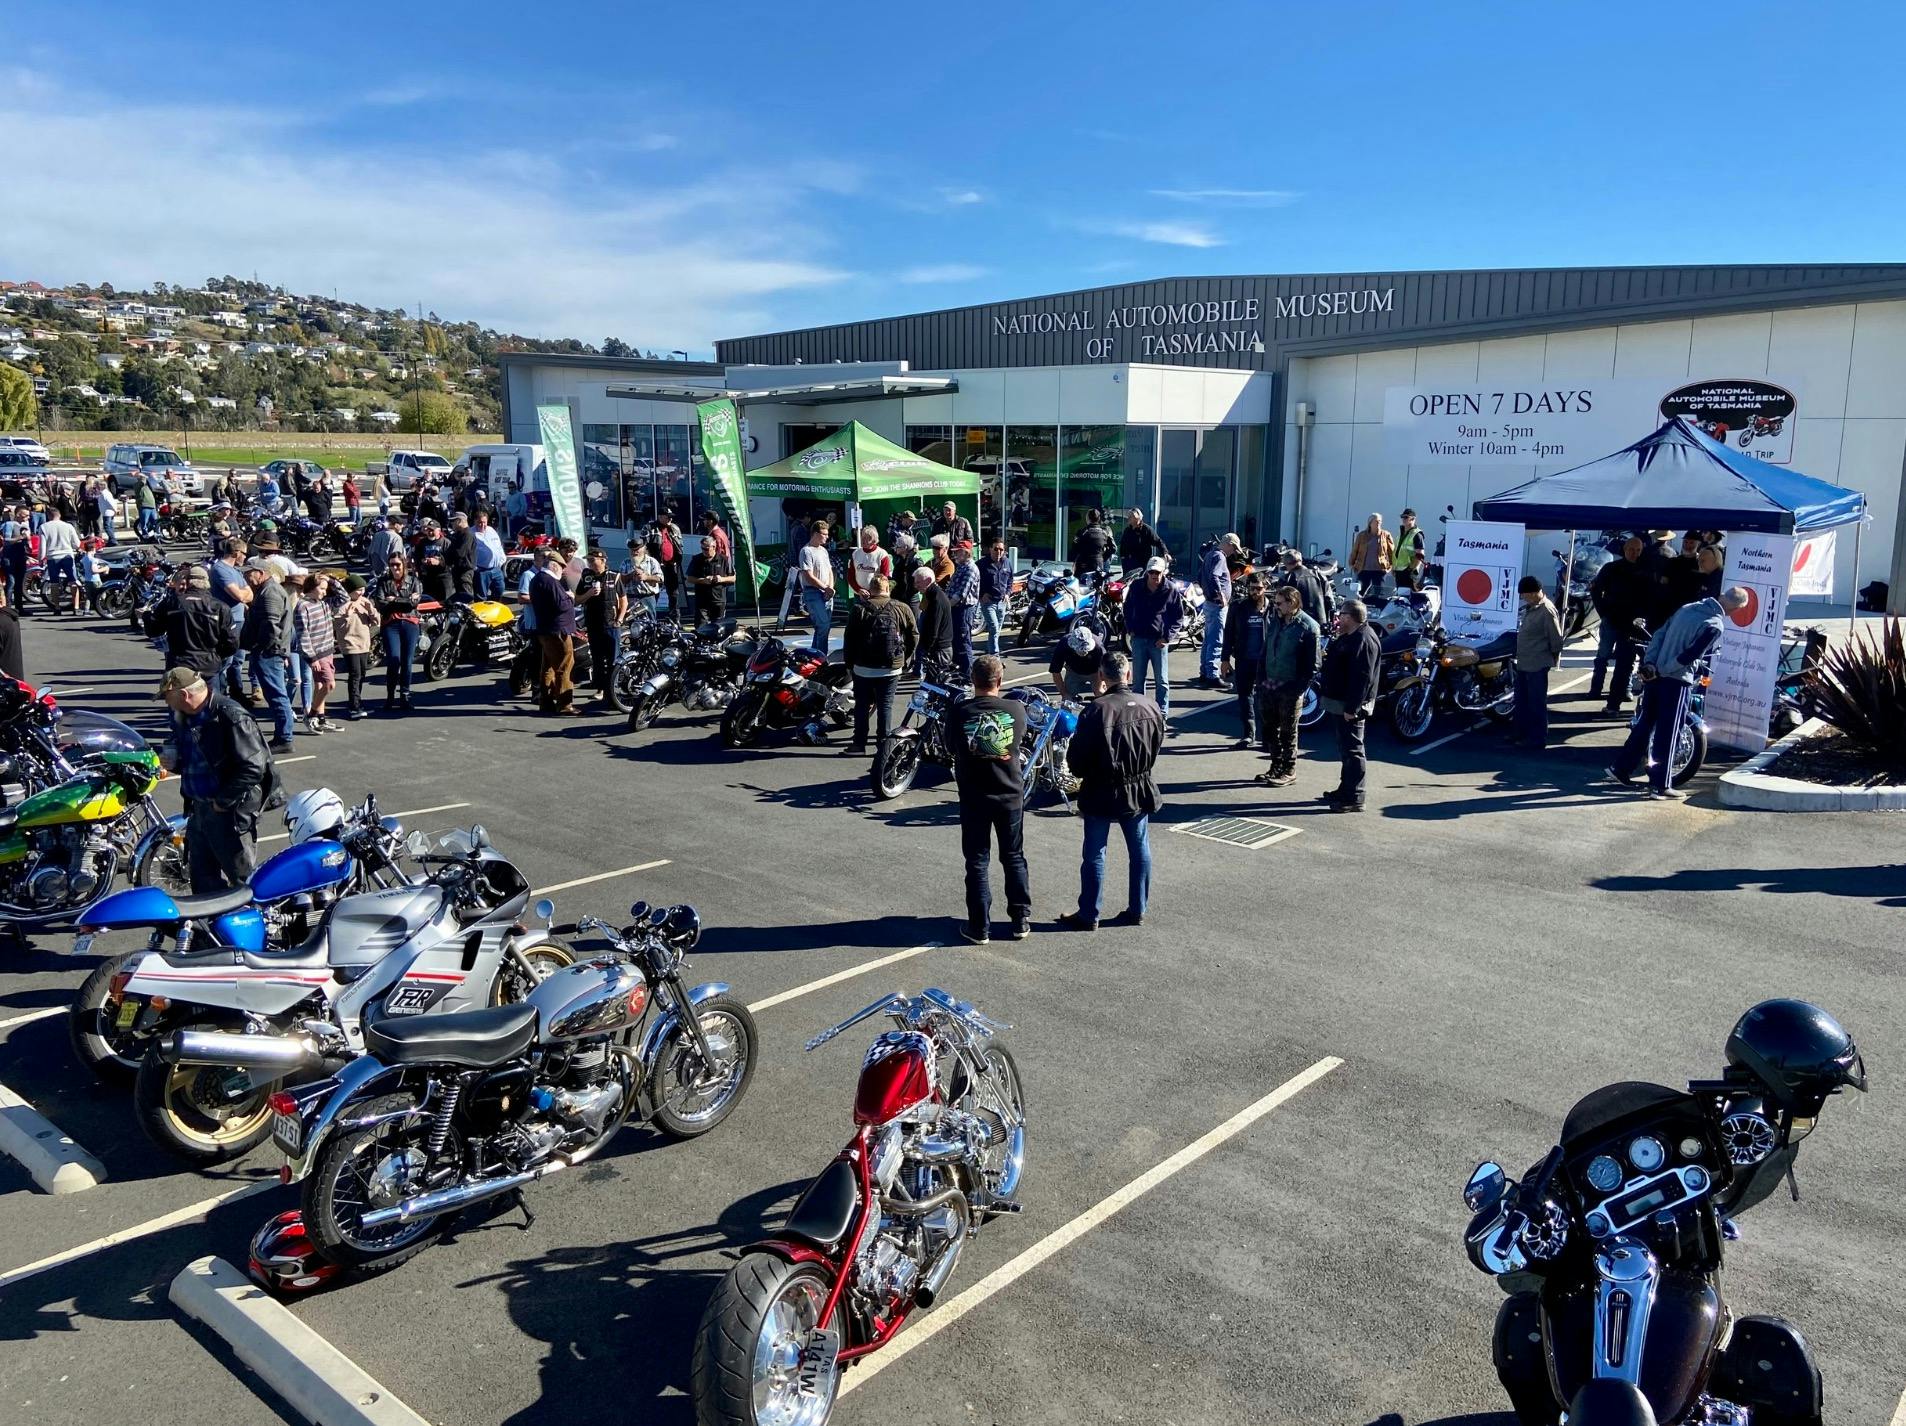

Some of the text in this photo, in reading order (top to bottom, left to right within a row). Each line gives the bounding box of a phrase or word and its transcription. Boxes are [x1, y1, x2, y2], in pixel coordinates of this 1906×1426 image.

[993, 288, 1396, 335] NATIONAL AUTOMOBILE MUSEUM
[1086, 330, 1265, 359] OF TASMANIA
[1409, 390, 1593, 416] OPEN 7 DAYS
[1738, 394, 1786, 402] MUSEUM
[1689, 402, 1762, 410] OF TASMANIA
[1457, 424, 1487, 438] 9am
[1502, 424, 1534, 441] 5pm
[1428, 441, 1474, 456] Winter
[1479, 441, 1516, 455] 10am
[1531, 441, 1564, 458] 4pm
[766, 483, 779, 491] FOR
[779, 483, 811, 492] MOTORING
[811, 486, 852, 495] ENTHUSIASTS
[902, 481, 933, 490] SHANNONS
[933, 480, 949, 488] CLUB
[1458, 538, 1509, 550] Tasmania
[1741, 547, 1773, 559] Northern
[1738, 561, 1772, 573] Tasmania
[388, 987, 435, 1008] FZR
[387, 1006, 425, 1015] GENESIS
[800, 1331, 827, 1394] A141W
[820, 1356, 833, 1374] TAS
